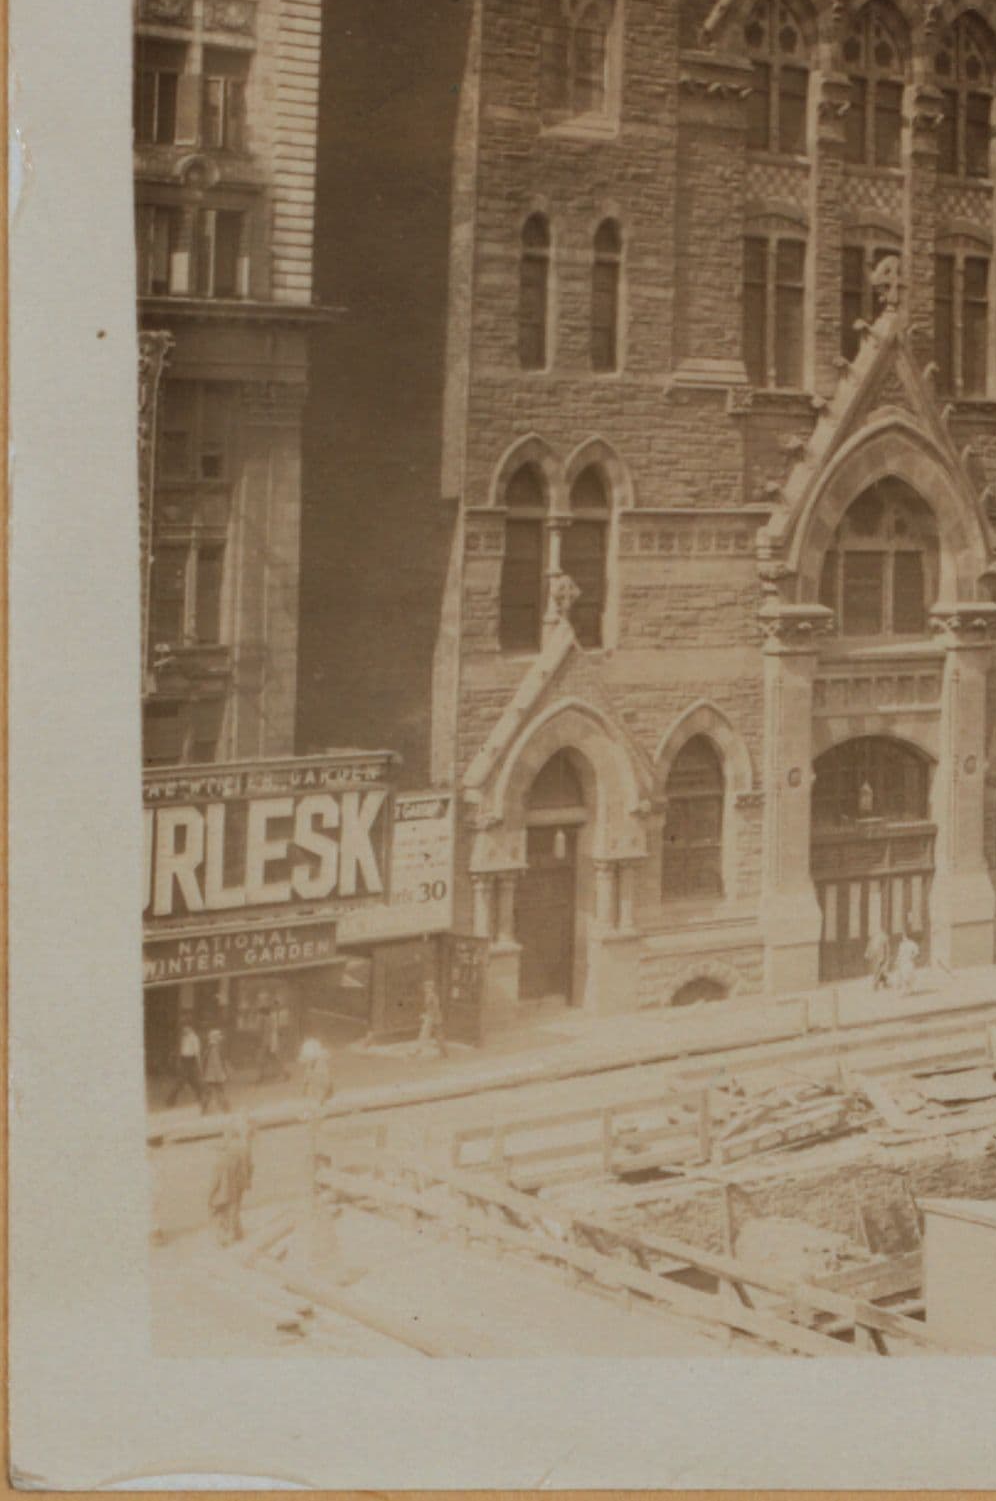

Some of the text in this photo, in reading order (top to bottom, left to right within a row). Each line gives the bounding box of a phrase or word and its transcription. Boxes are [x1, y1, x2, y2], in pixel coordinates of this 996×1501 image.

[418, 879, 447, 902] 30
[178, 929, 297, 956] NATIONAL
[143, 940, 330, 977] WINTER GARDEN
